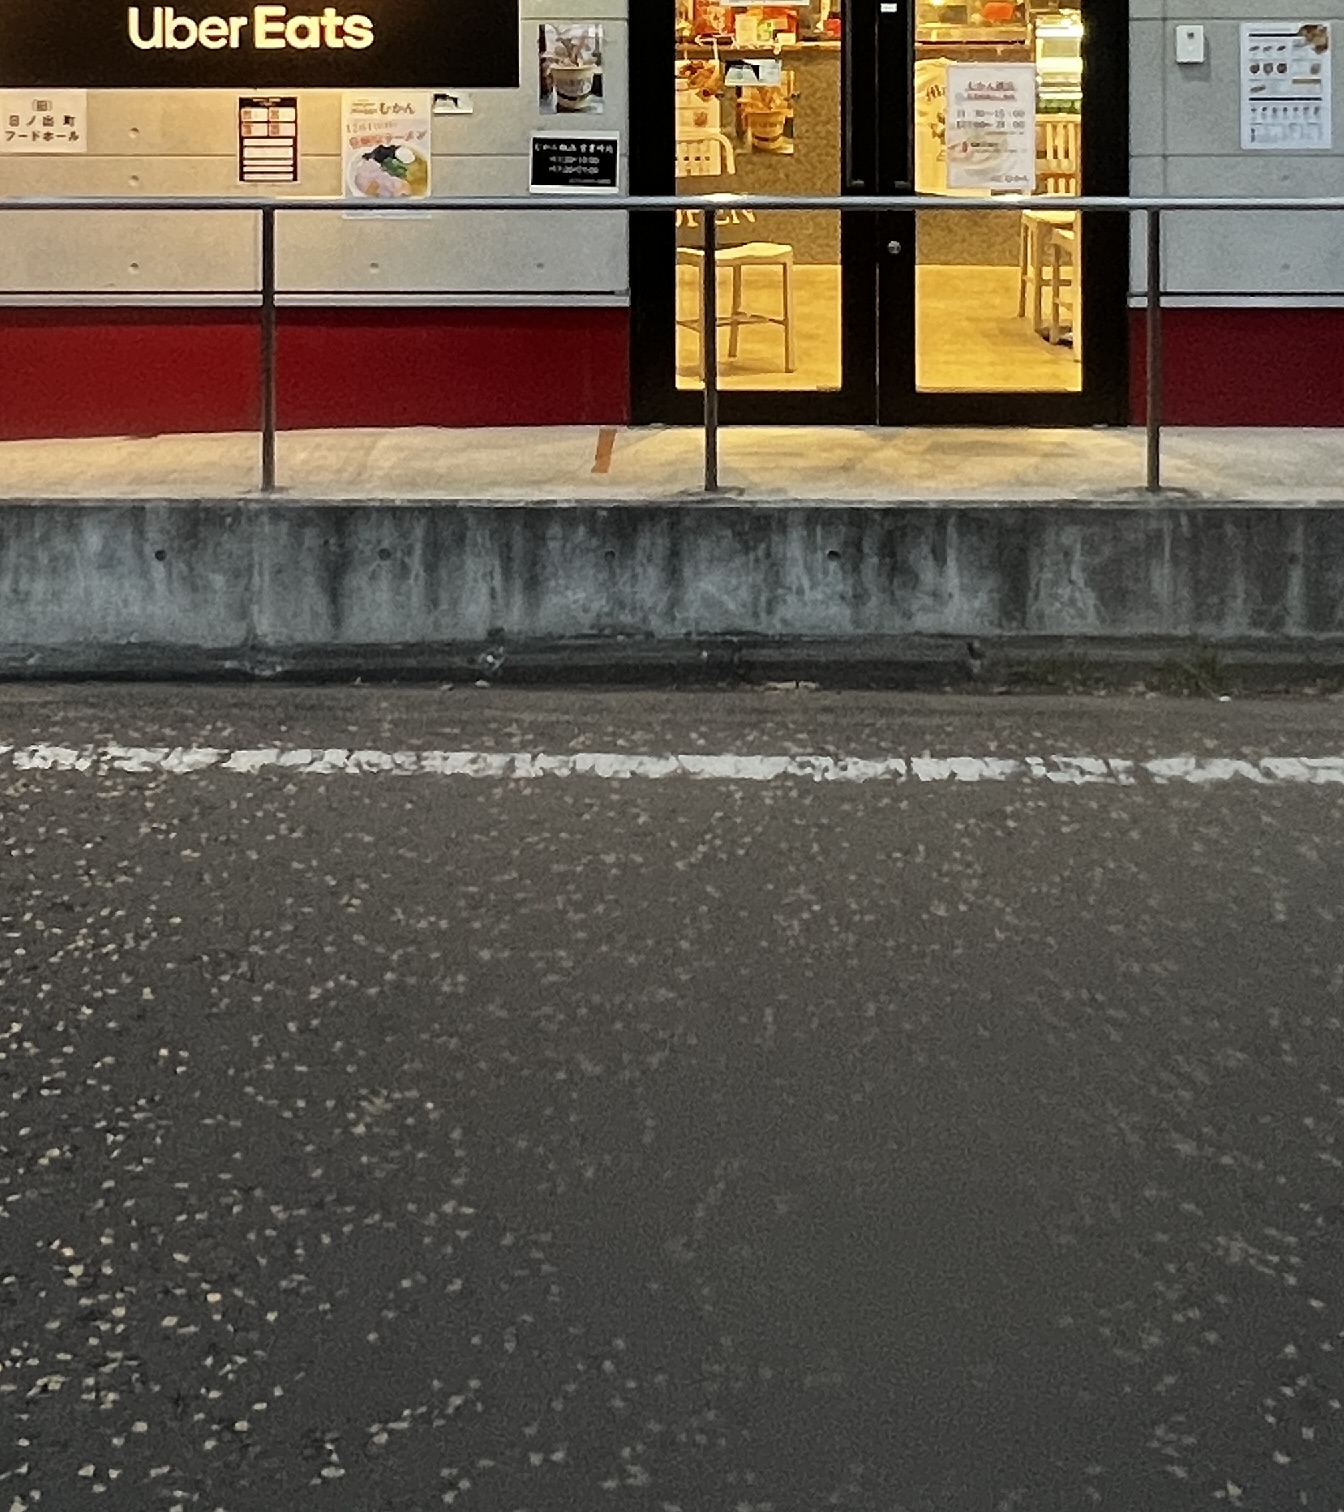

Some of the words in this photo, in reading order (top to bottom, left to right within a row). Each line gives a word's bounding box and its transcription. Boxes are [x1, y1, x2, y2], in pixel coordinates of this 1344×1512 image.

[127, 6, 248, 50] Uber
[253, 4, 375, 49] Eats
[379, 102, 415, 115] むかん
[8, 114, 76, 128] 日ノ出町
[4, 130, 80, 142] フードホール
